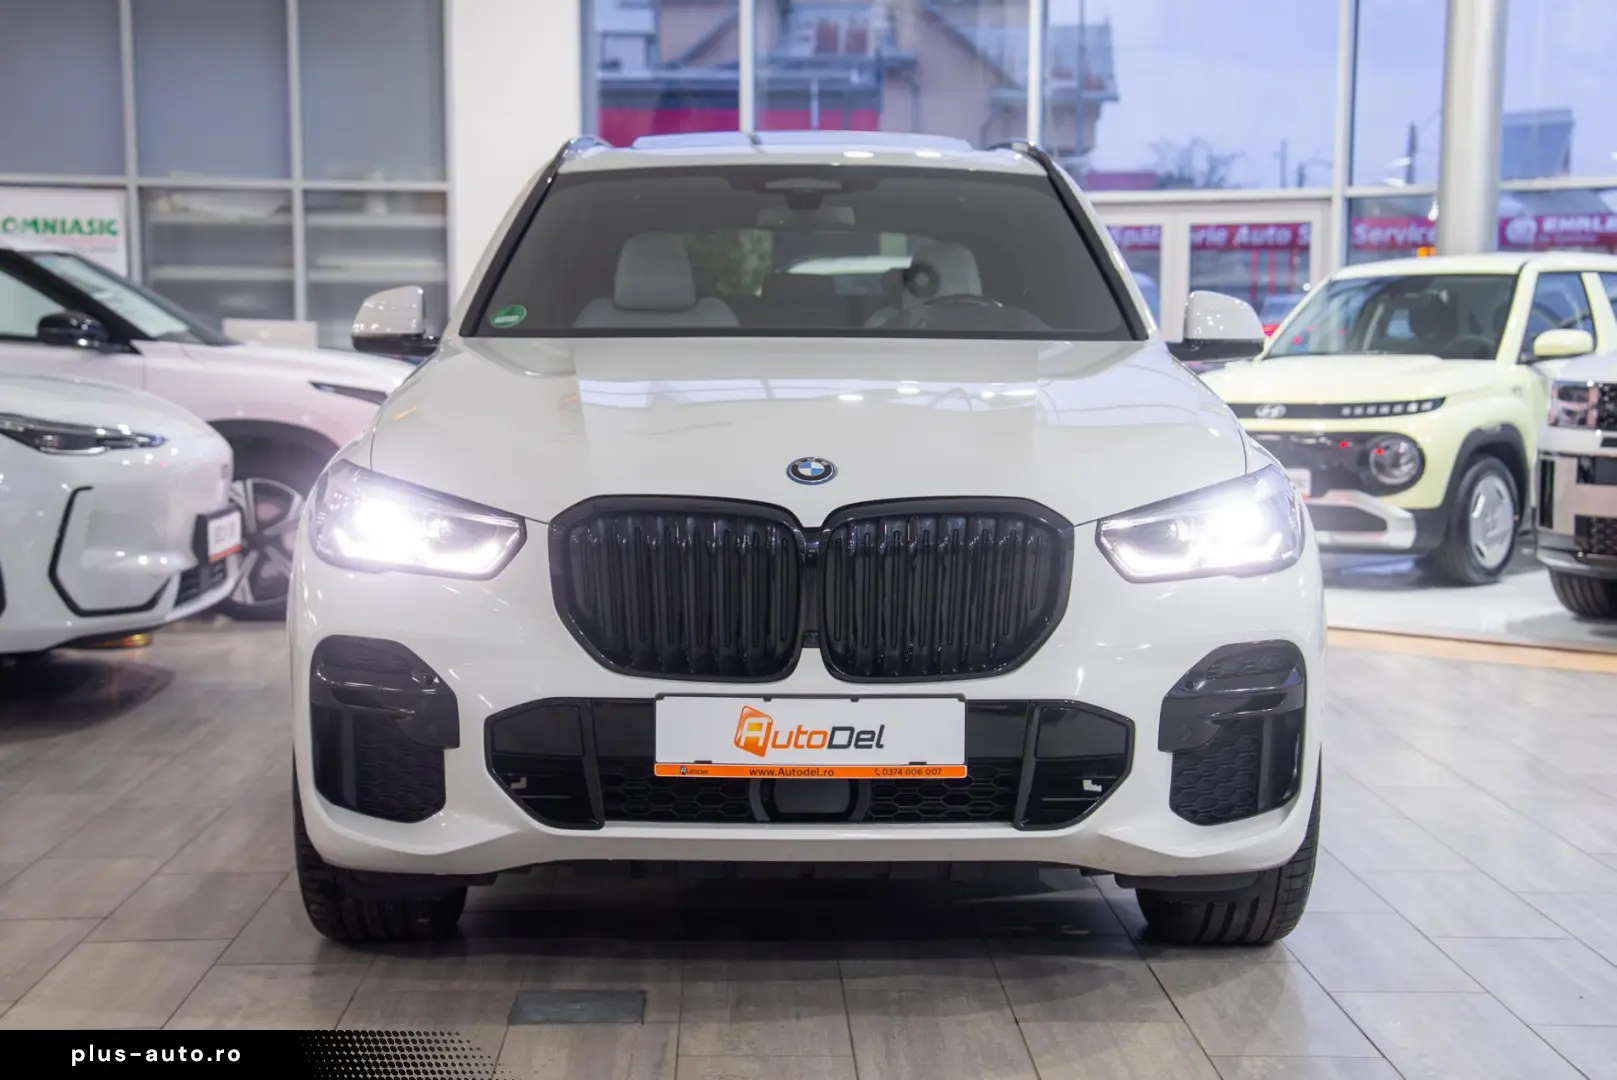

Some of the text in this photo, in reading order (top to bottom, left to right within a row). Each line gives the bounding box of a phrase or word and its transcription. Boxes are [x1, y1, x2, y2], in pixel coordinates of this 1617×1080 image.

[1232, 223, 1292, 246] Auto
[738, 714, 885, 749] AutoDel
[749, 766, 834, 777] www.Autodel.ro
[882, 767, 902, 776] 0374
[905, 767, 923, 776] 006
[925, 767, 942, 776] 007
